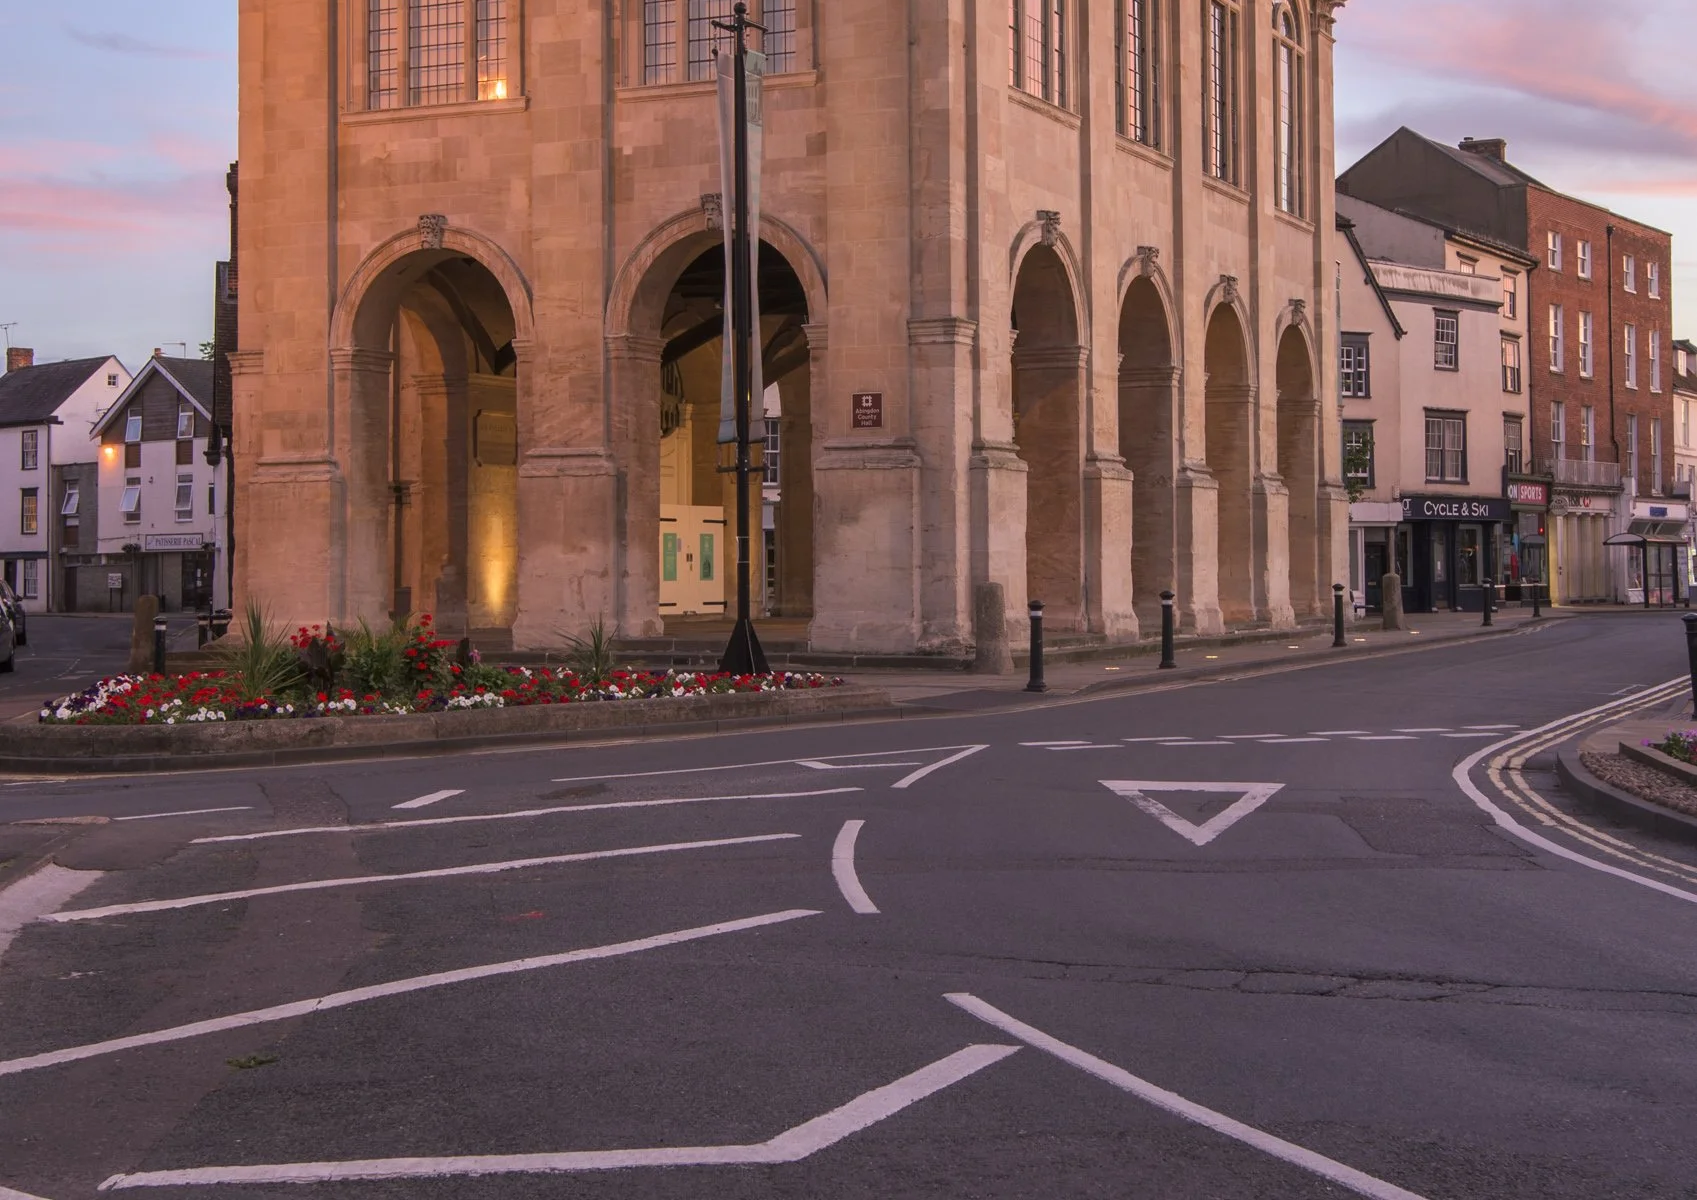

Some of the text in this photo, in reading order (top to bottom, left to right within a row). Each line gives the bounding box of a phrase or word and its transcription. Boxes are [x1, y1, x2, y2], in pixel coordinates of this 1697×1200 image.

[1520, 486, 1542, 500] SPORTS
[1424, 501, 1459, 516] CYCLE
[1461, 502, 1469, 516] &
[1471, 502, 1489, 517] SKI
